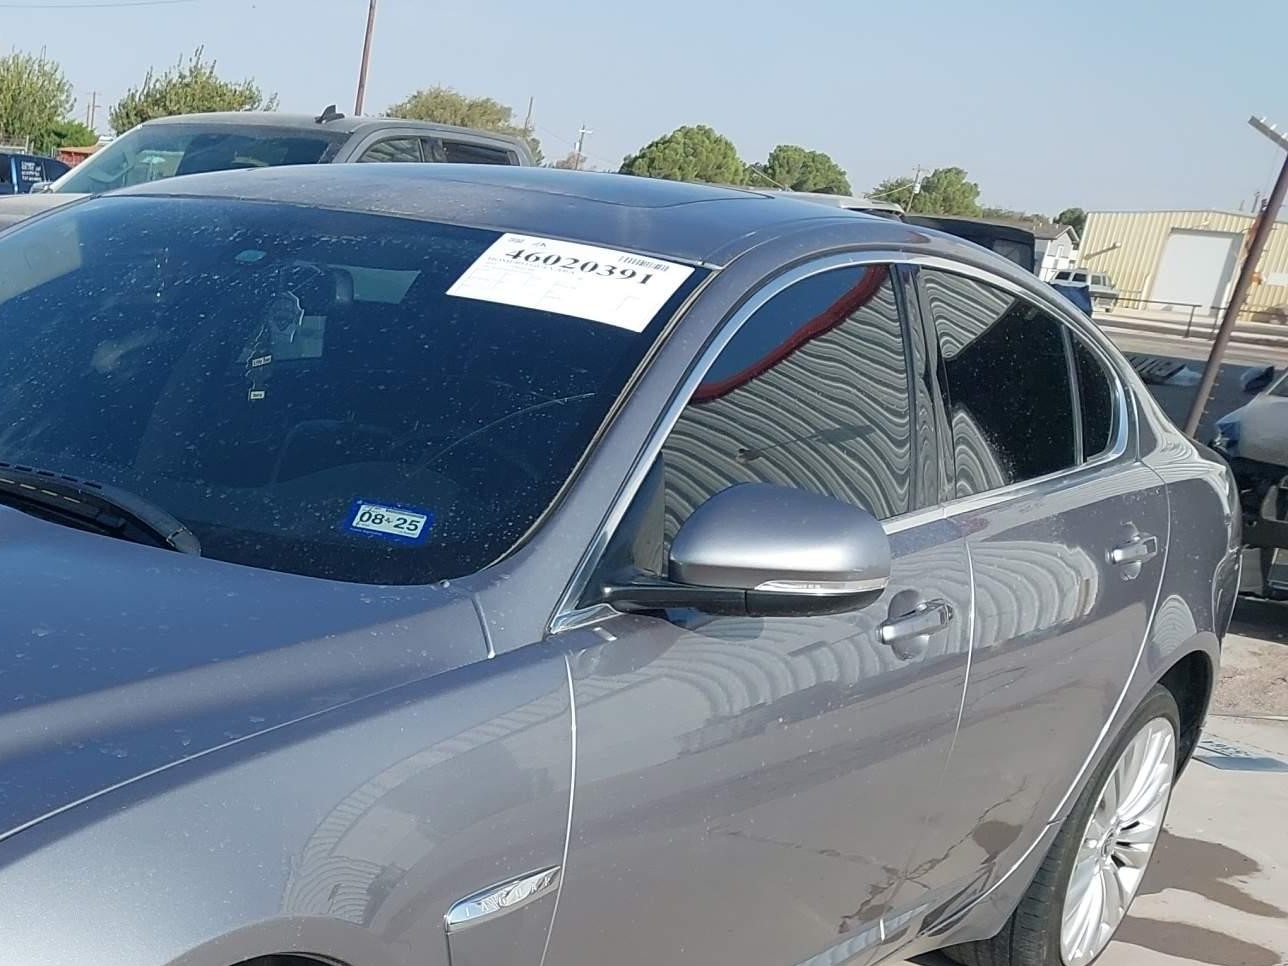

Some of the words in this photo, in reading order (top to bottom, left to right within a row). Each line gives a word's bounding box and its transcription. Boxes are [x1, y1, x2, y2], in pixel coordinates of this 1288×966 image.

[505, 248, 654, 285] 46020391
[359, 511, 385, 525] 08
[393, 517, 421, 532] 25
